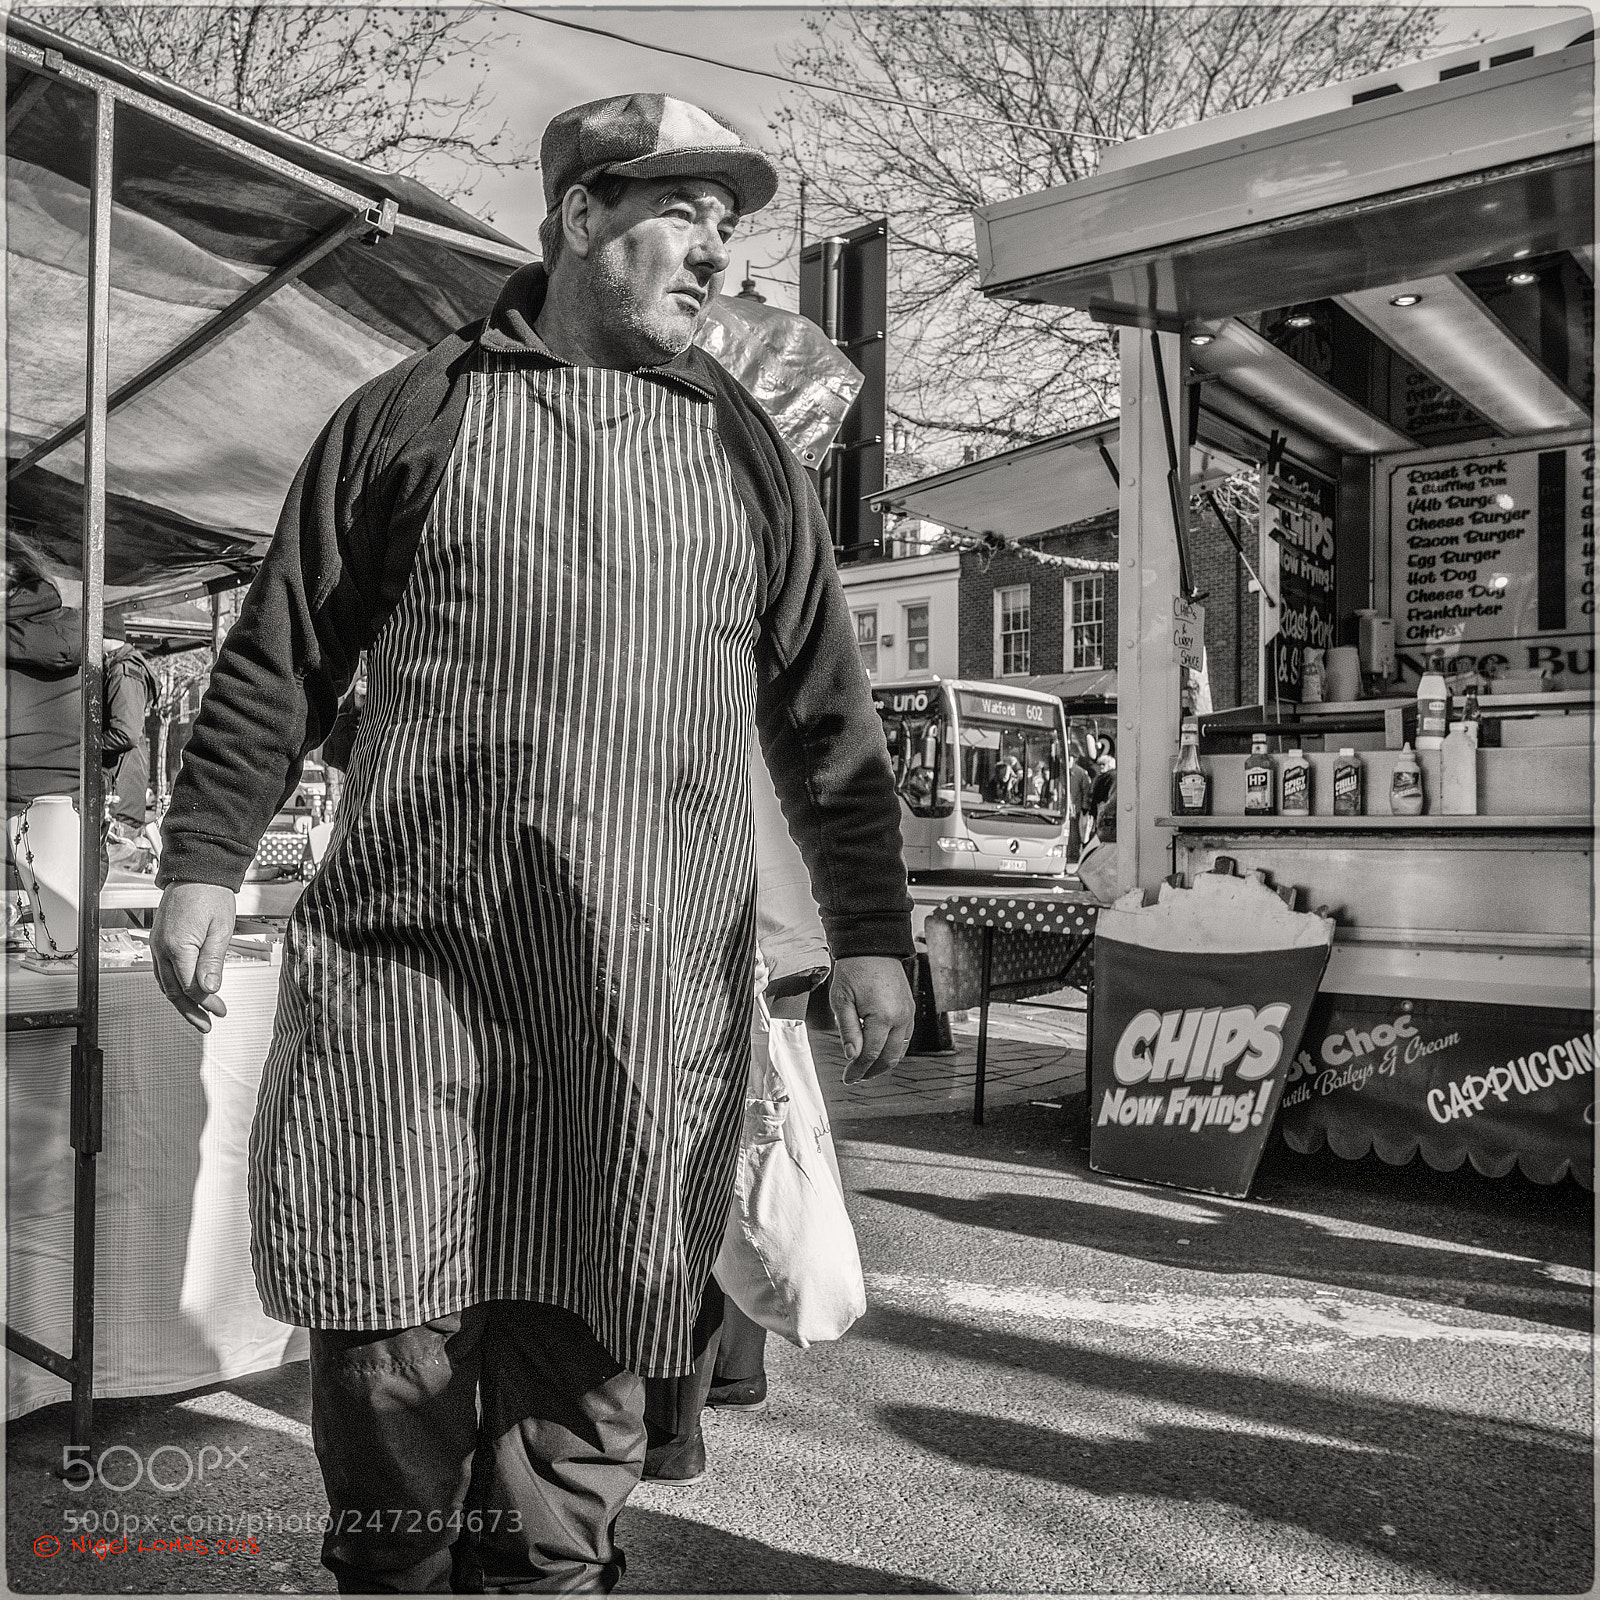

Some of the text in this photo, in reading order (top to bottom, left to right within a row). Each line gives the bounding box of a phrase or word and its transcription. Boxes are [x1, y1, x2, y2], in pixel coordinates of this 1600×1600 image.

[1407, 459, 1507, 484] Roast Pork
[1407, 486, 1418, 496] &
[1479, 477, 1507, 488] Bun
[1445, 494, 1505, 509] Burge
[1407, 509, 1531, 532] Cheese Burger
[1407, 528, 1525, 550] Bacon Burger
[1407, 550, 1501, 568] Egg Burger
[1407, 569, 1477, 586] Hot Dog
[1406, 589, 1464, 604] Cheese
[1407, 604, 1503, 622] Frankfurter
[1310, 606, 1334, 650] Pork
[1406, 623, 1459, 639] Chips
[981, 699, 1043, 721] Watford 602
[1249, 775, 1266, 786] HP
[1284, 775, 1307, 791] SPICY
[1113, 1002, 1291, 1085] CHIPS
[1321, 1014, 1418, 1066] Choc
[1282, 1082, 1311, 1108] with
[1313, 1063, 1374, 1096] Baileys
[1404, 1031, 1461, 1064] Cream
[1097, 1079, 1275, 1133] Now Frying!
